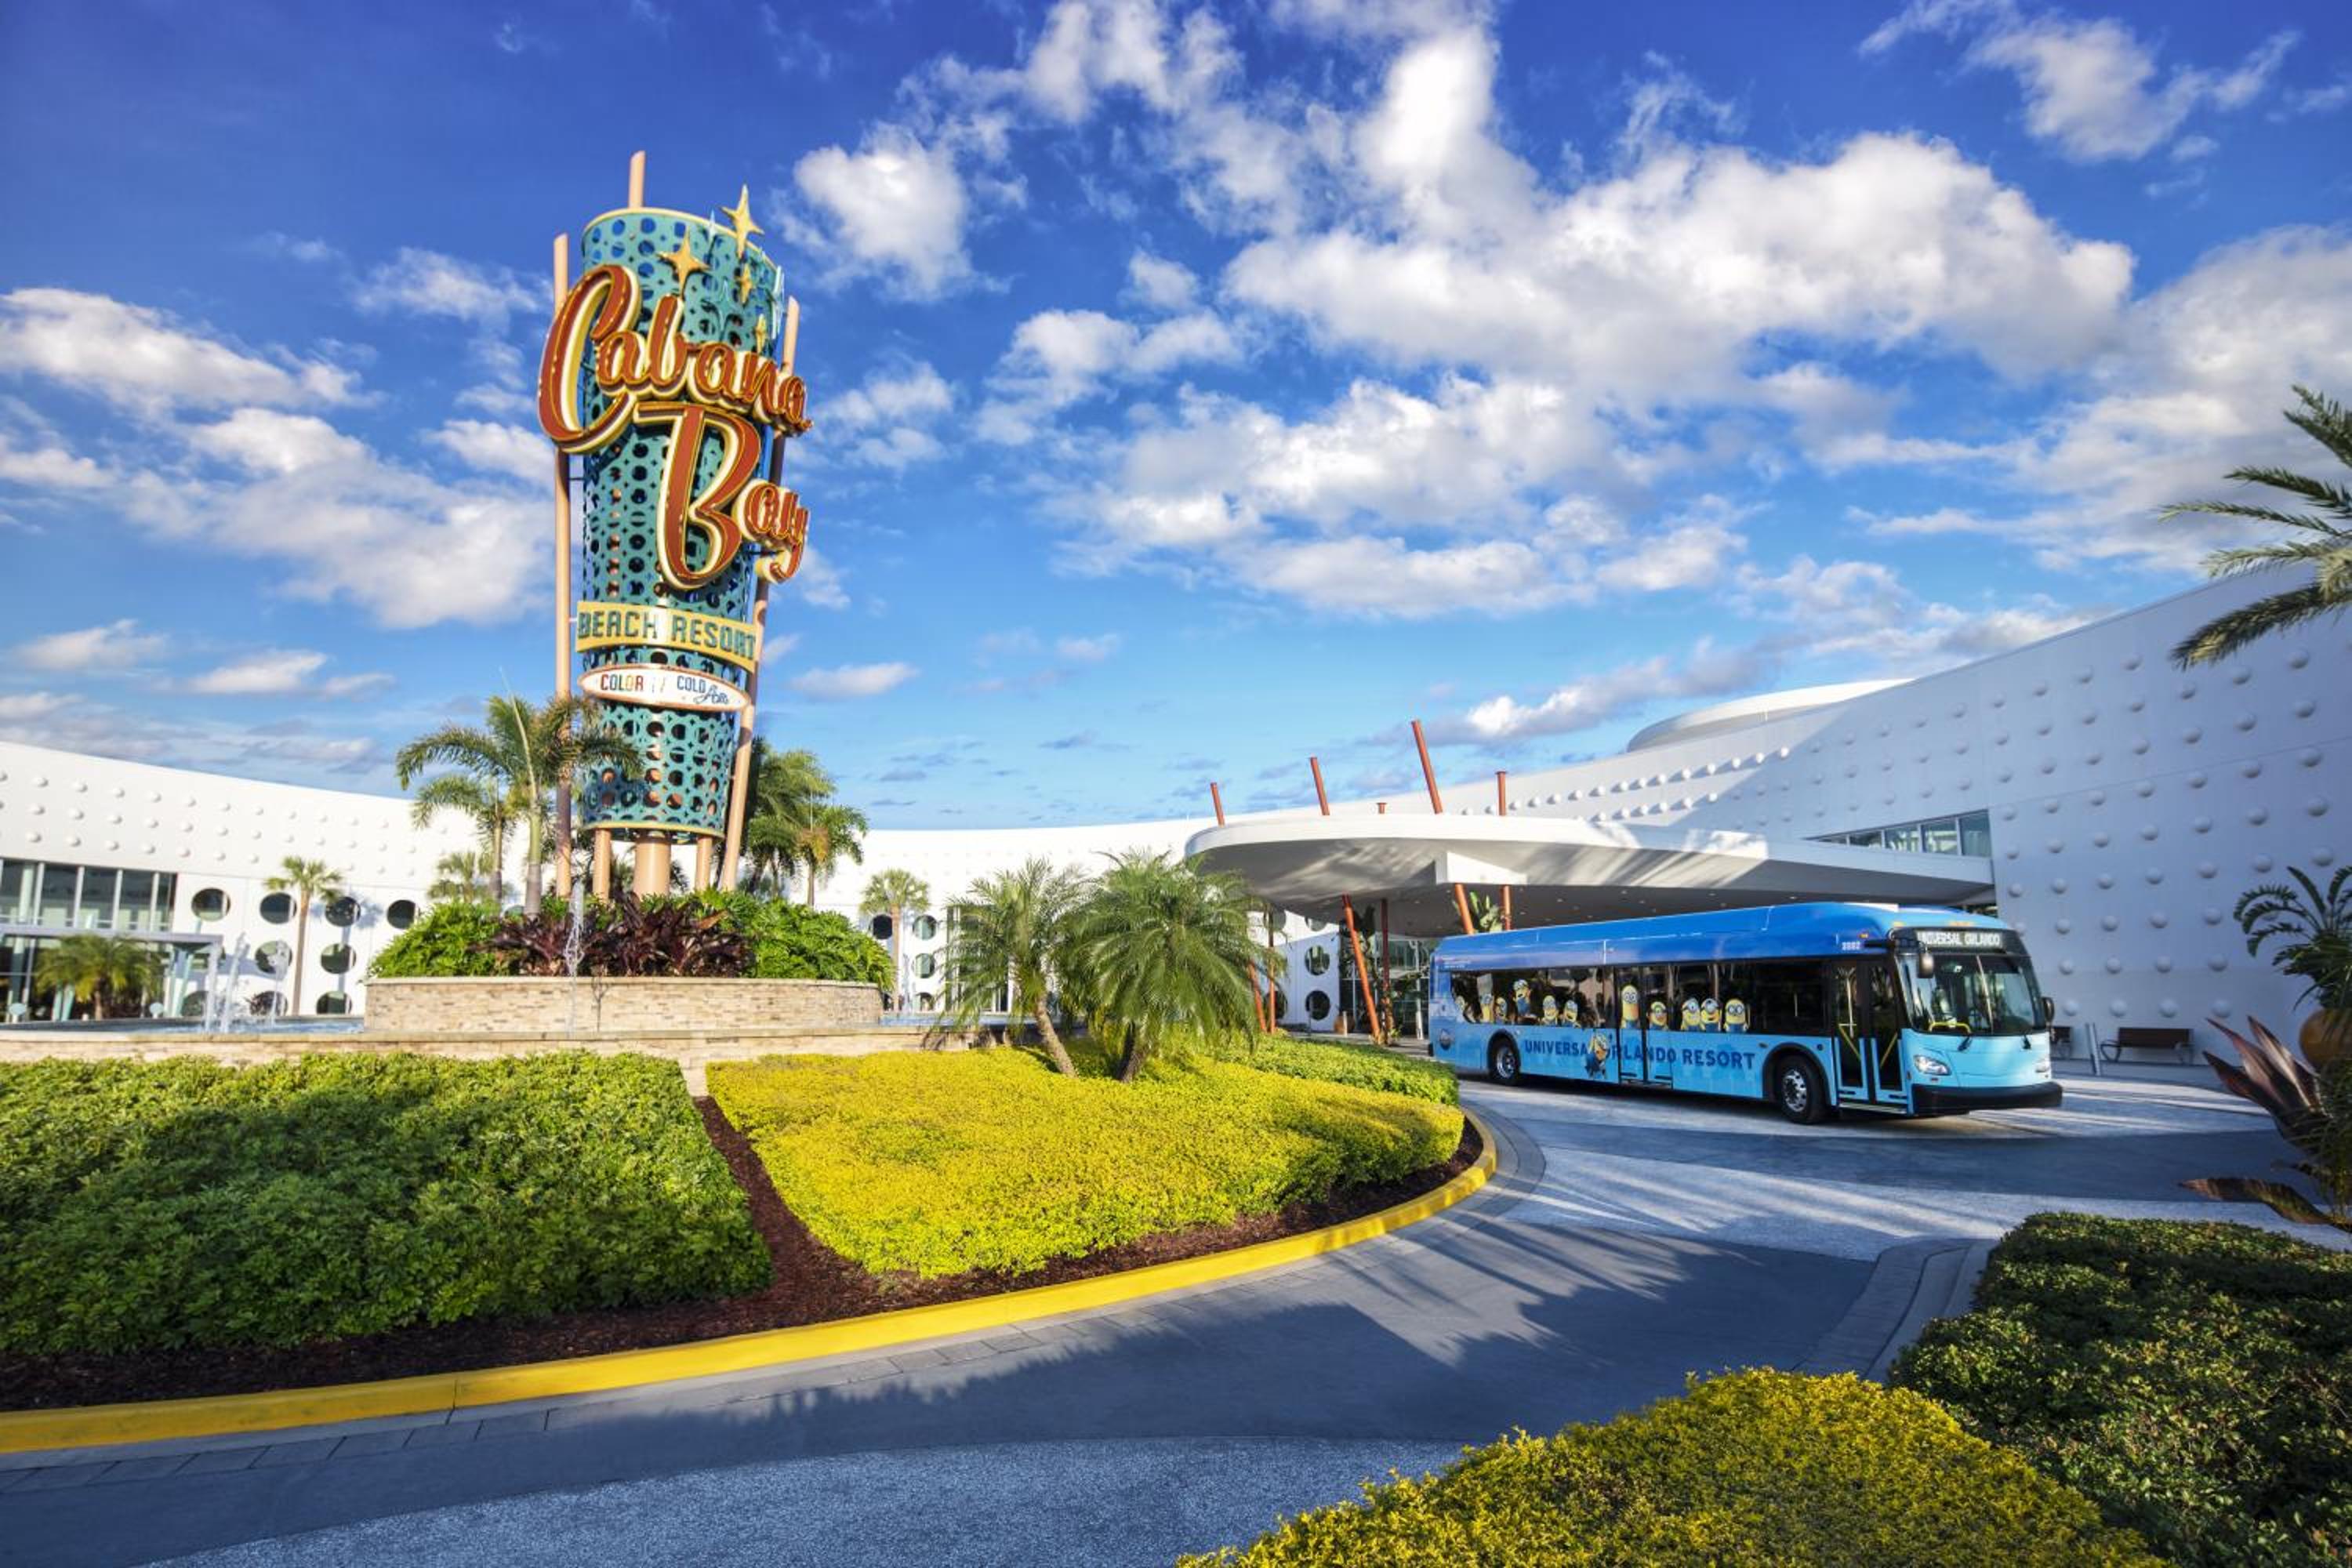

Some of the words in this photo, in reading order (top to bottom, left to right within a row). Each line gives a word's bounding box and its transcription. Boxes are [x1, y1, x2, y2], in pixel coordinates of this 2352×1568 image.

[538, 263, 814, 453] Cabana
[633, 401, 810, 590] Bay
[577, 610, 658, 640] BEACH
[671, 614, 757, 660] RESORT
[600, 673, 644, 691] COLOR
[677, 675, 706, 694] COLD
[1524, 1040, 1588, 1057] UNIVERSA
[1682, 1048, 1755, 1070] RESORT
